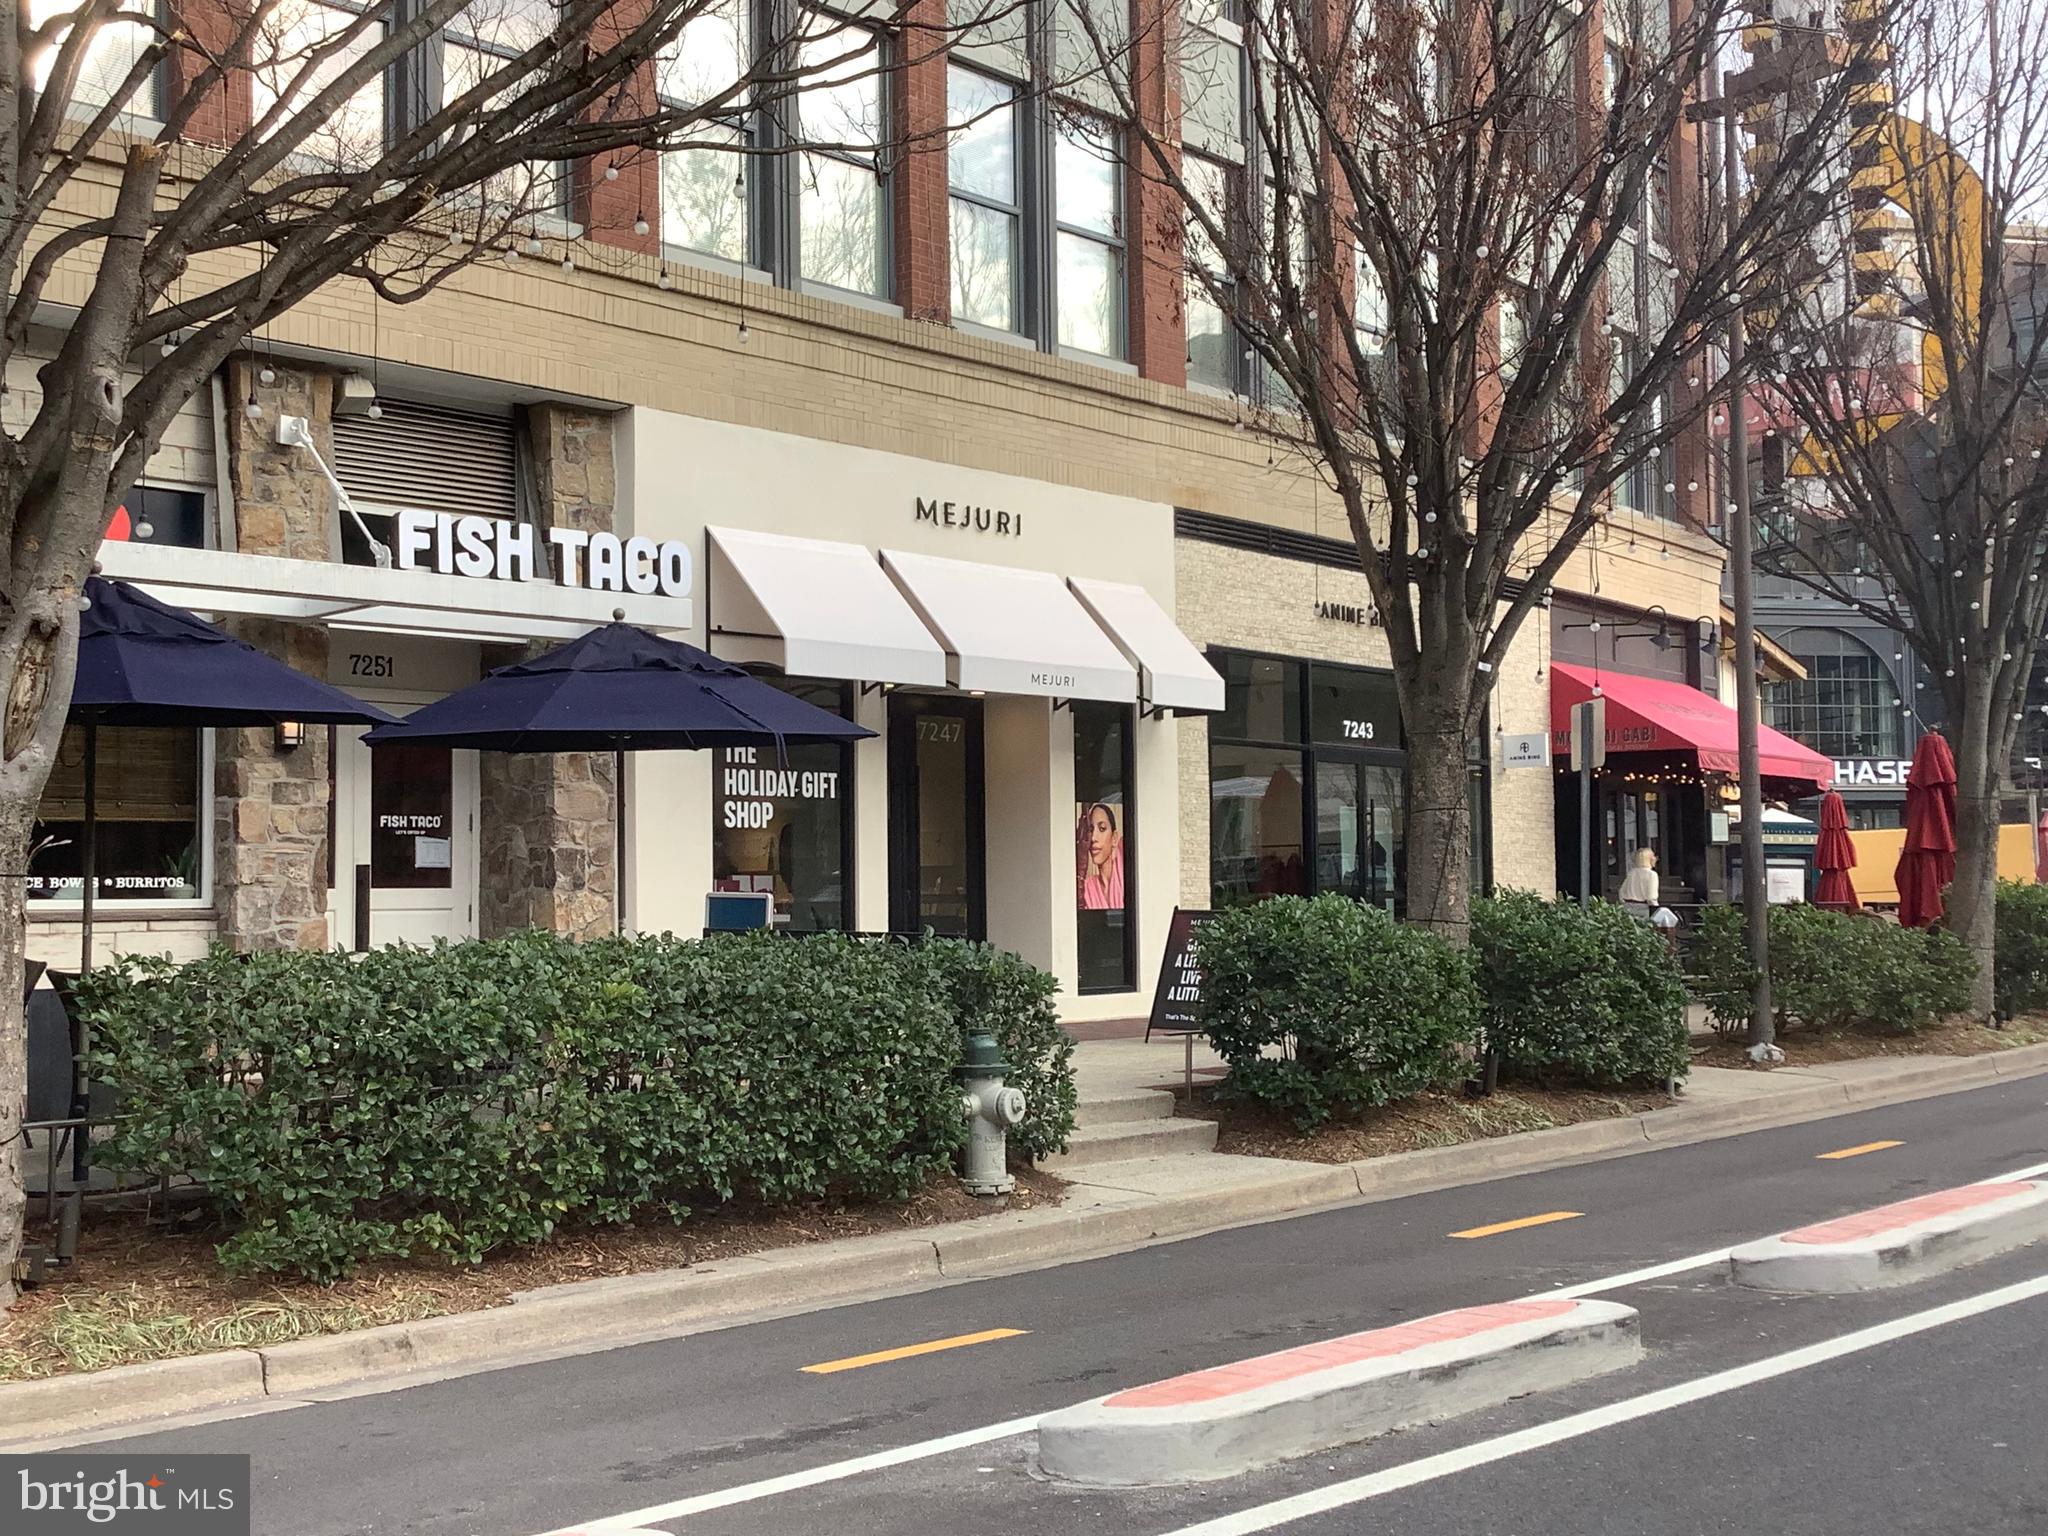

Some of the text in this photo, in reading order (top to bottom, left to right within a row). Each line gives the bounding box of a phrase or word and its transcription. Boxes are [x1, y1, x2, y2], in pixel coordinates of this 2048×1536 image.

[916, 497, 1022, 536] MEJURI
[396, 509, 693, 597] FISH TACO
[1320, 601, 1365, 625] ANINE
[349, 654, 394, 677] 7251
[1031, 673, 1075, 687] MEJURI
[919, 721, 961, 742] 7247
[1343, 720, 1374, 739] 7243
[724, 768, 838, 798] HOLIDAY GIFT
[1827, 760, 1913, 784] HASE
[380, 815, 442, 828] FISH TACO
[724, 800, 774, 829] SHOP
[116, 876, 185, 889] BURRITOS
[1174, 953, 1183, 968] A
[1167, 985, 1176, 1001] A
